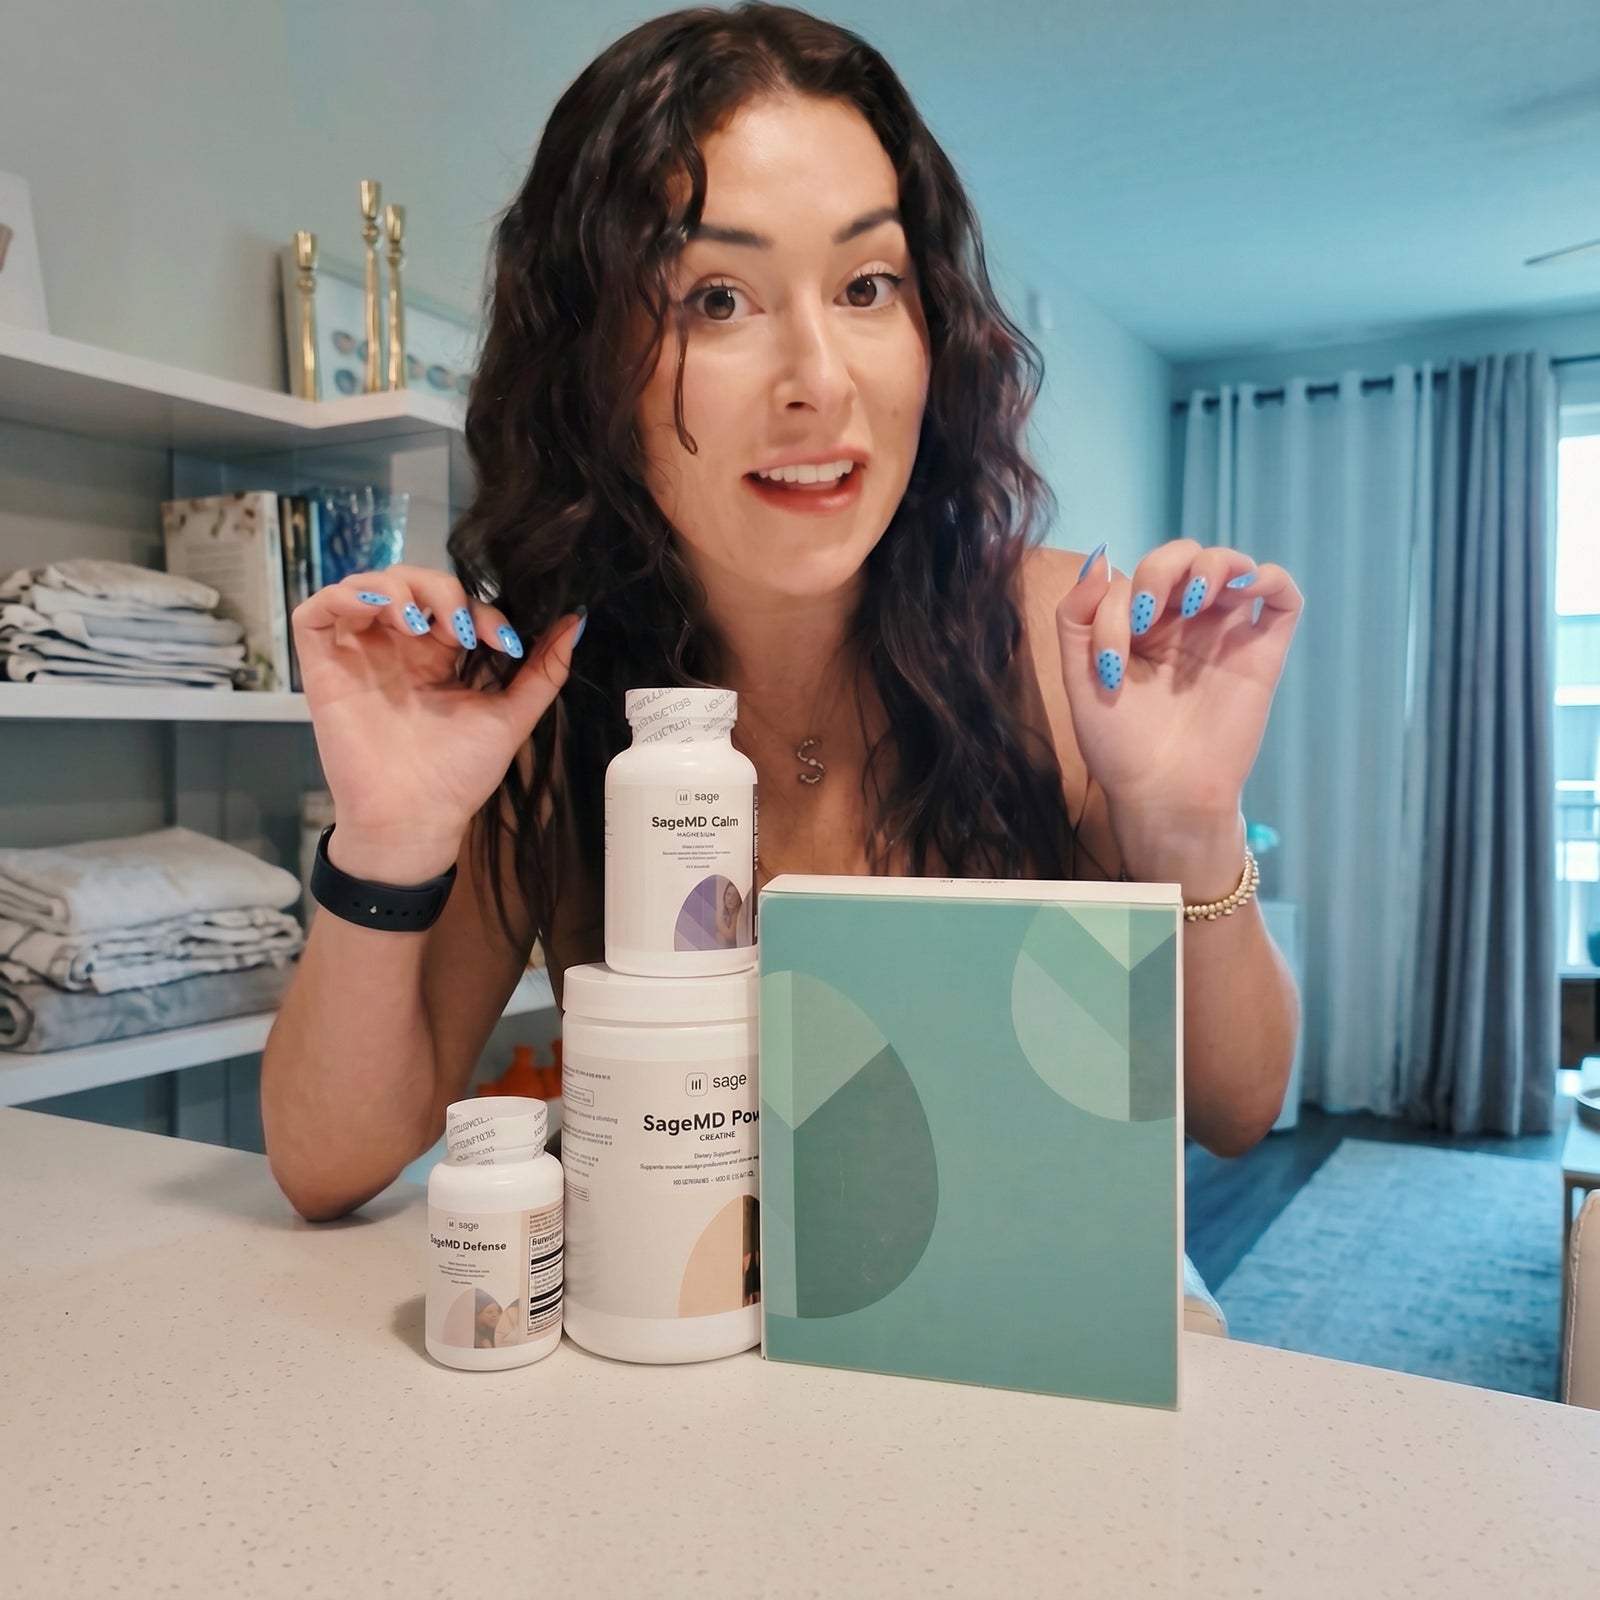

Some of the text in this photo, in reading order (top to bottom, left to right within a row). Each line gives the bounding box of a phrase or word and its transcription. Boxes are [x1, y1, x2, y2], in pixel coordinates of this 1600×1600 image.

[694, 793, 720, 804] sage
[651, 816, 739, 830] SageMD Calm
[712, 1074, 747, 1091] sage
[643, 1112, 726, 1136] SageMD
[699, 1130, 736, 1142] CREATINE
[458, 1222, 479, 1232] sage
[430, 1233, 507, 1251] SageMD Defense
